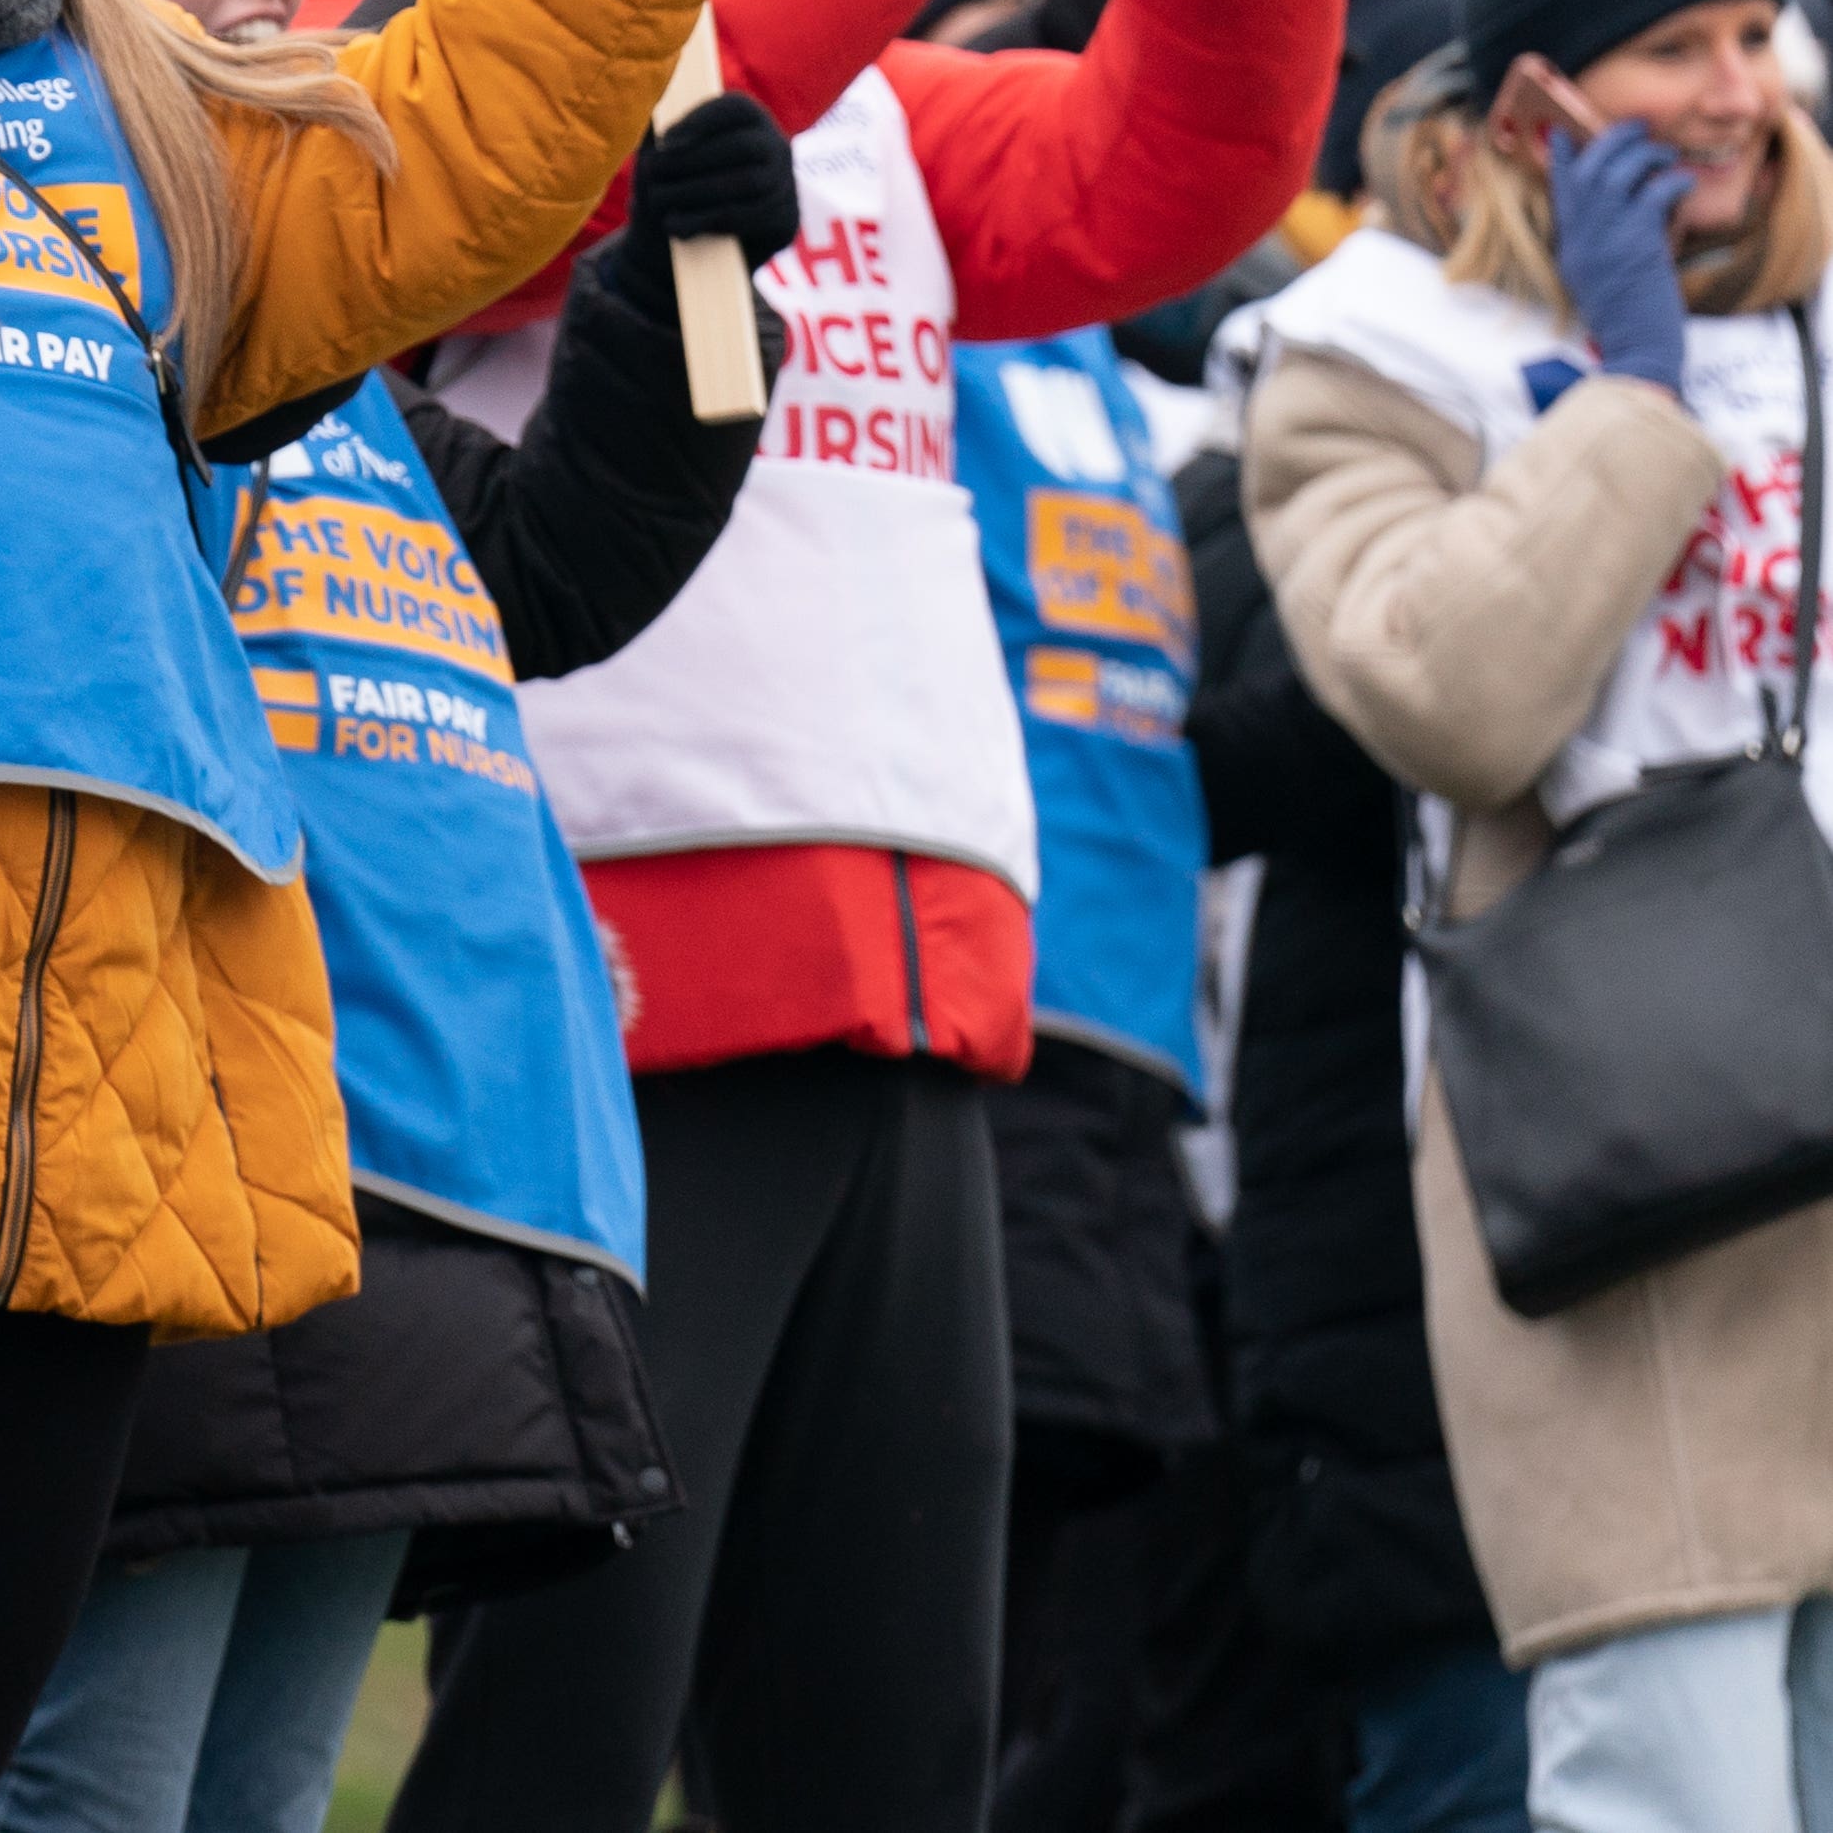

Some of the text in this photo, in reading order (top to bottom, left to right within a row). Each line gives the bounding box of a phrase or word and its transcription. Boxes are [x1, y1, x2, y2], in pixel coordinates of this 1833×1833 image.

[36, 331, 114, 382] PAY
[329, 673, 427, 722] FAIR
[335, 716, 420, 765] FOR
